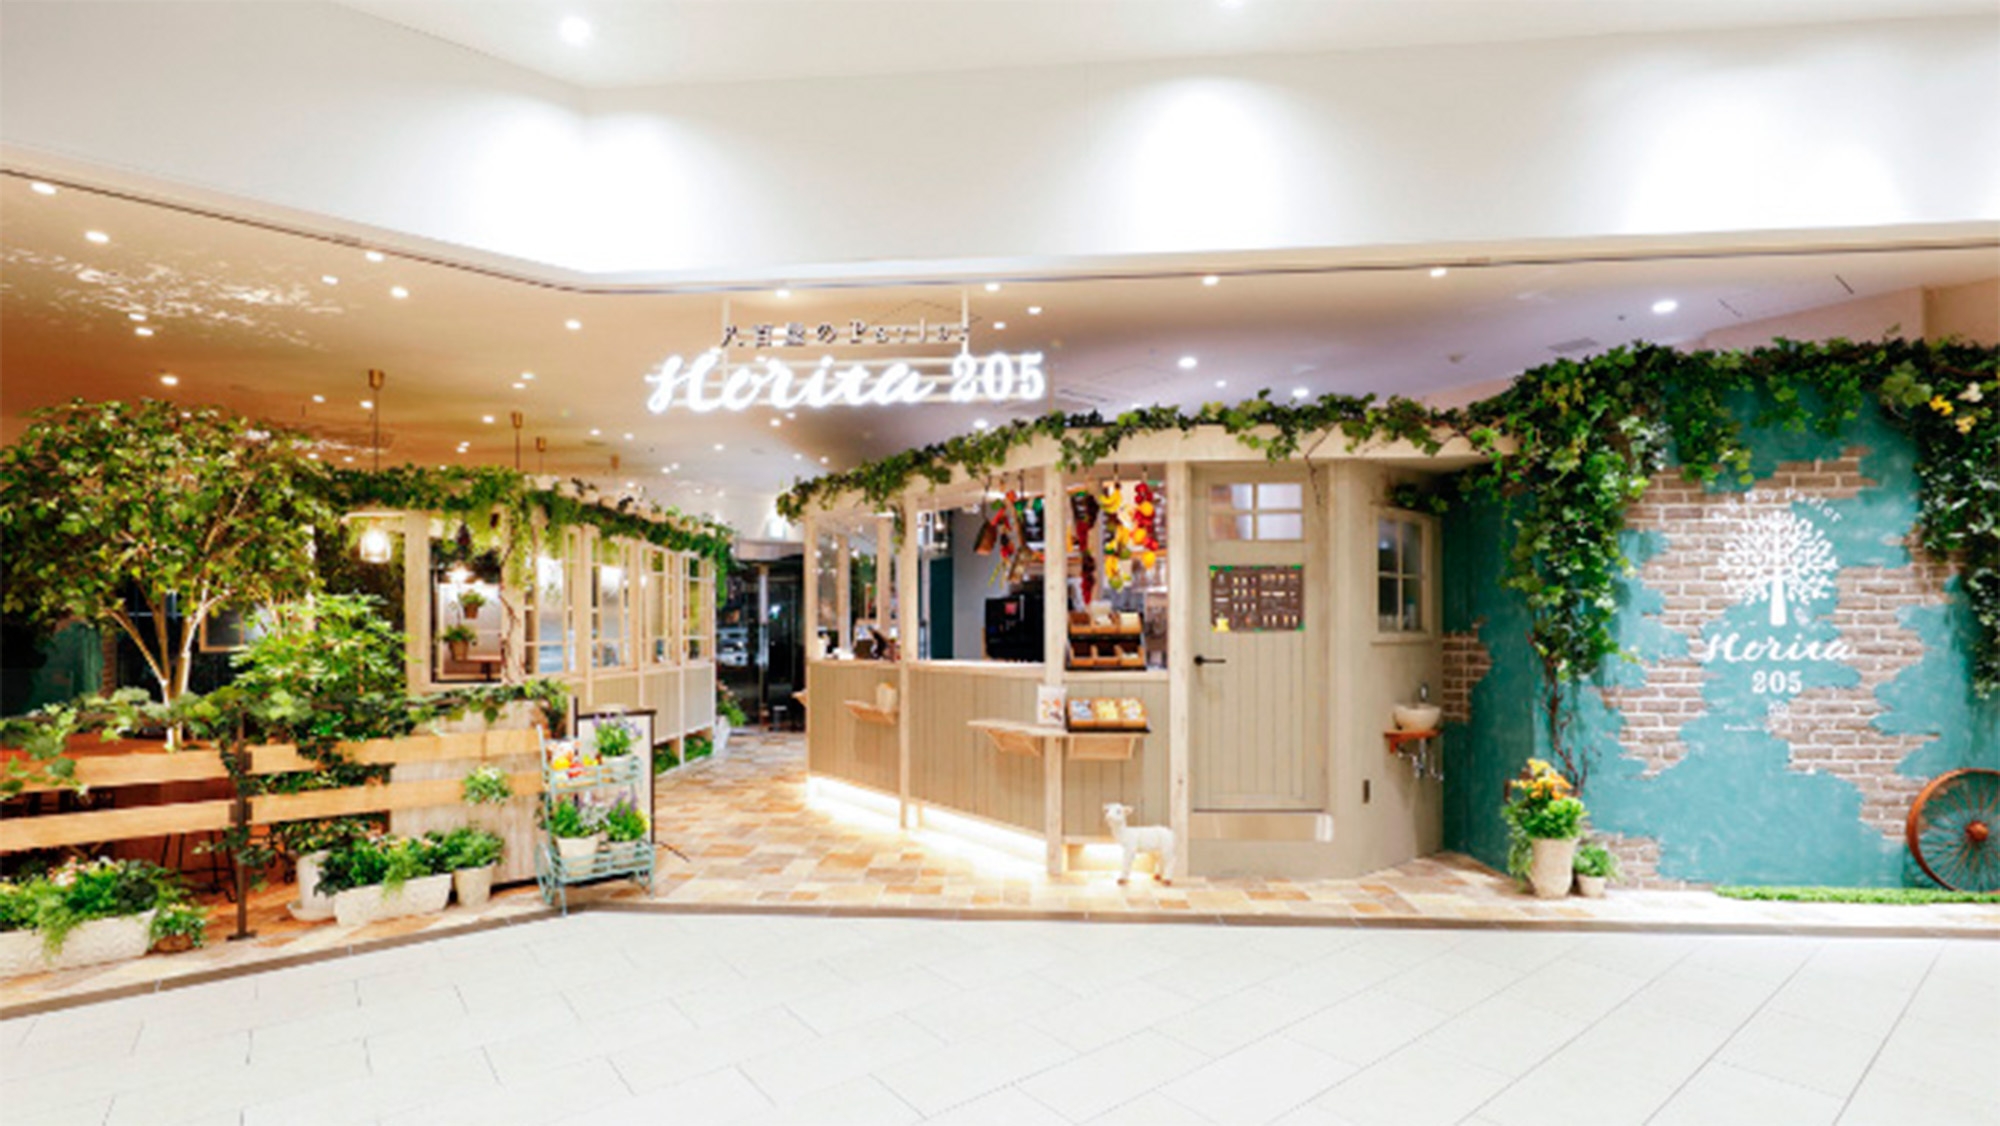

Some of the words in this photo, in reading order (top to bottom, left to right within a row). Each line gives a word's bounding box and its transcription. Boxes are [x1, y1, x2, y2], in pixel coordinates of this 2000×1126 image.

[646, 348, 936, 413] Horita
[951, 352, 1044, 401] 205
[1704, 632, 1855, 662] Horita
[1753, 671, 1802, 694] 205
